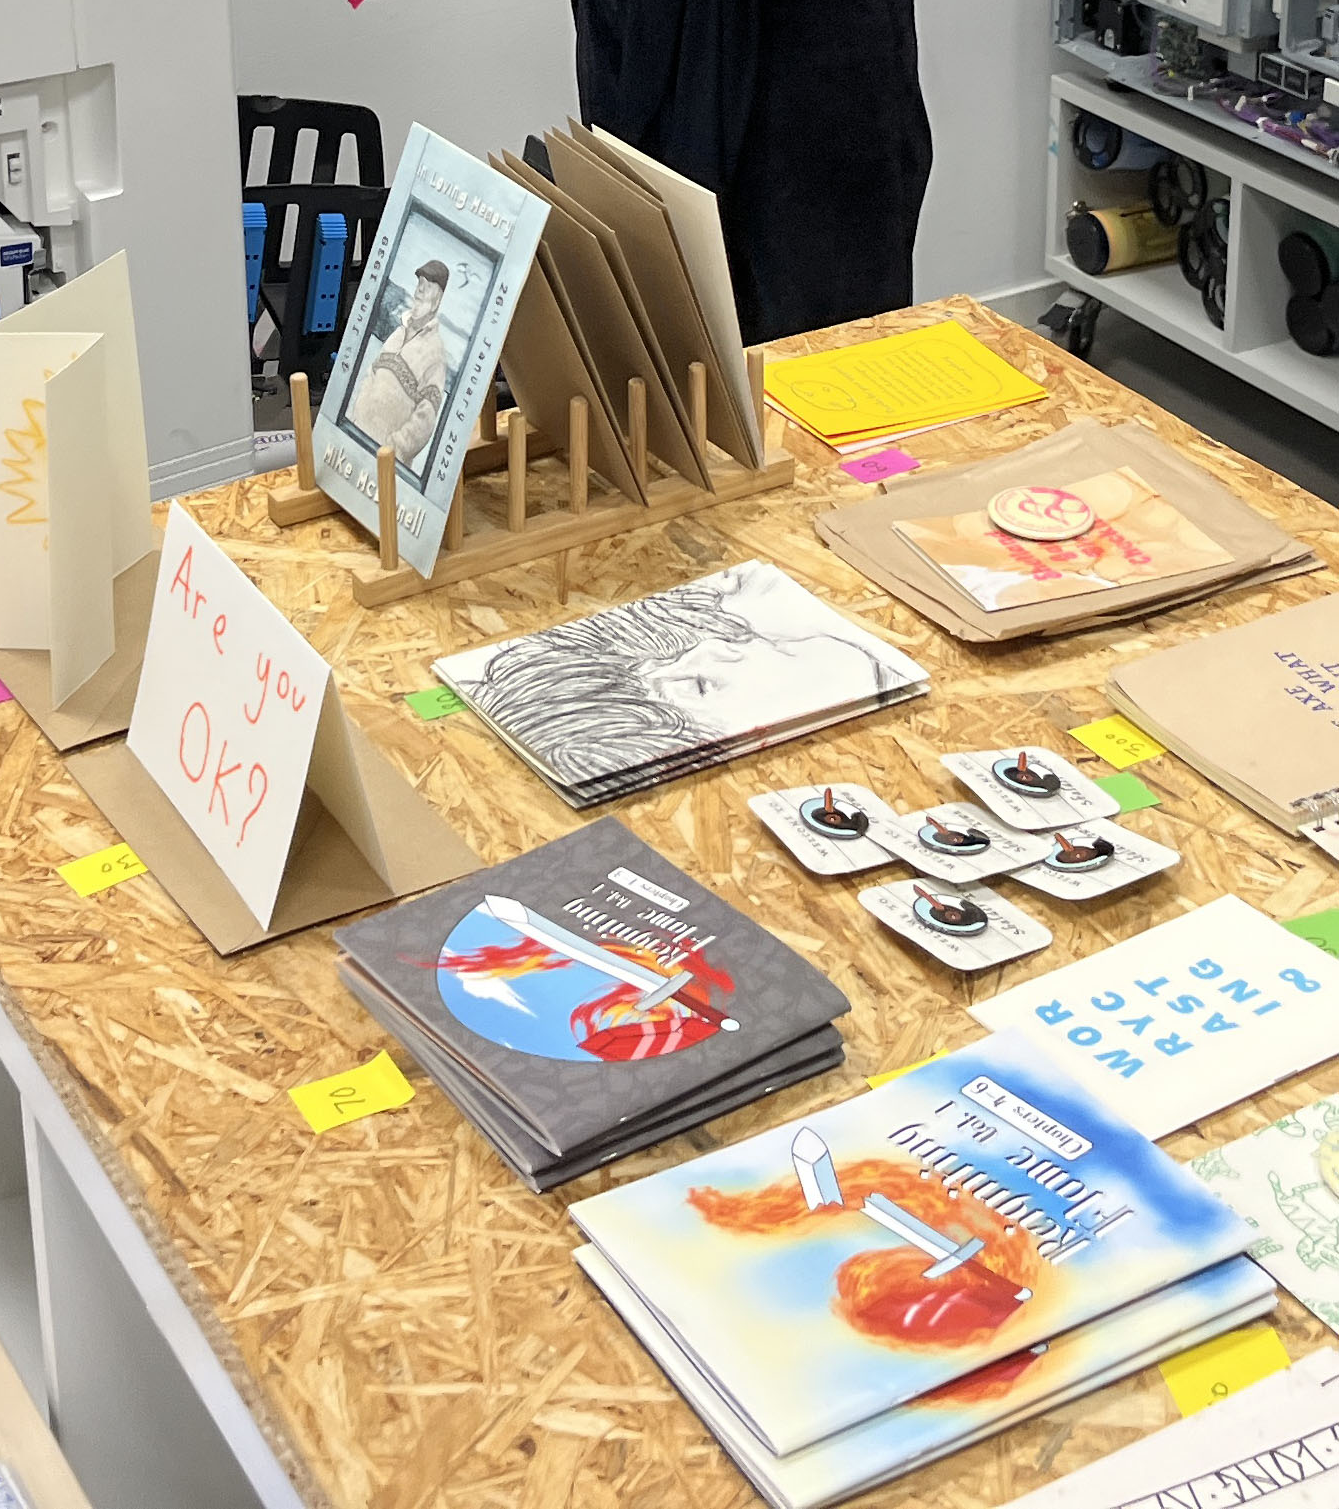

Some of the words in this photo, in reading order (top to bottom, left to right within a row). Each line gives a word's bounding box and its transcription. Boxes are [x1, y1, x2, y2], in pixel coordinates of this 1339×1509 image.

[429, 171, 469, 211] Loving
[470, 192, 516, 240] Memory
[456, 338, 492, 422] January
[323, 443, 353, 480] Mike
[436, 430, 458, 482] 2022
[170, 545, 227, 656] Are
[244, 652, 306, 724] you
[1274, 651, 1336, 693] WHAT
[1284, 685, 1333, 711] AXE
[179, 701, 268, 849] OK?
[636, 908, 717, 952] Flame
[1133, 976, 1243, 1033] AST
[1188, 958, 1282, 1016] ING
[1035, 999, 1146, 1079] WOR
[1091, 991, 1195, 1057] RYC
[957, 1112, 998, 1144] Vol.
[1013, 1104, 1084, 1155] Chapters
[886, 1122, 1092, 1265] Reigniting
[1004, 1145, 1135, 1238] Flame
